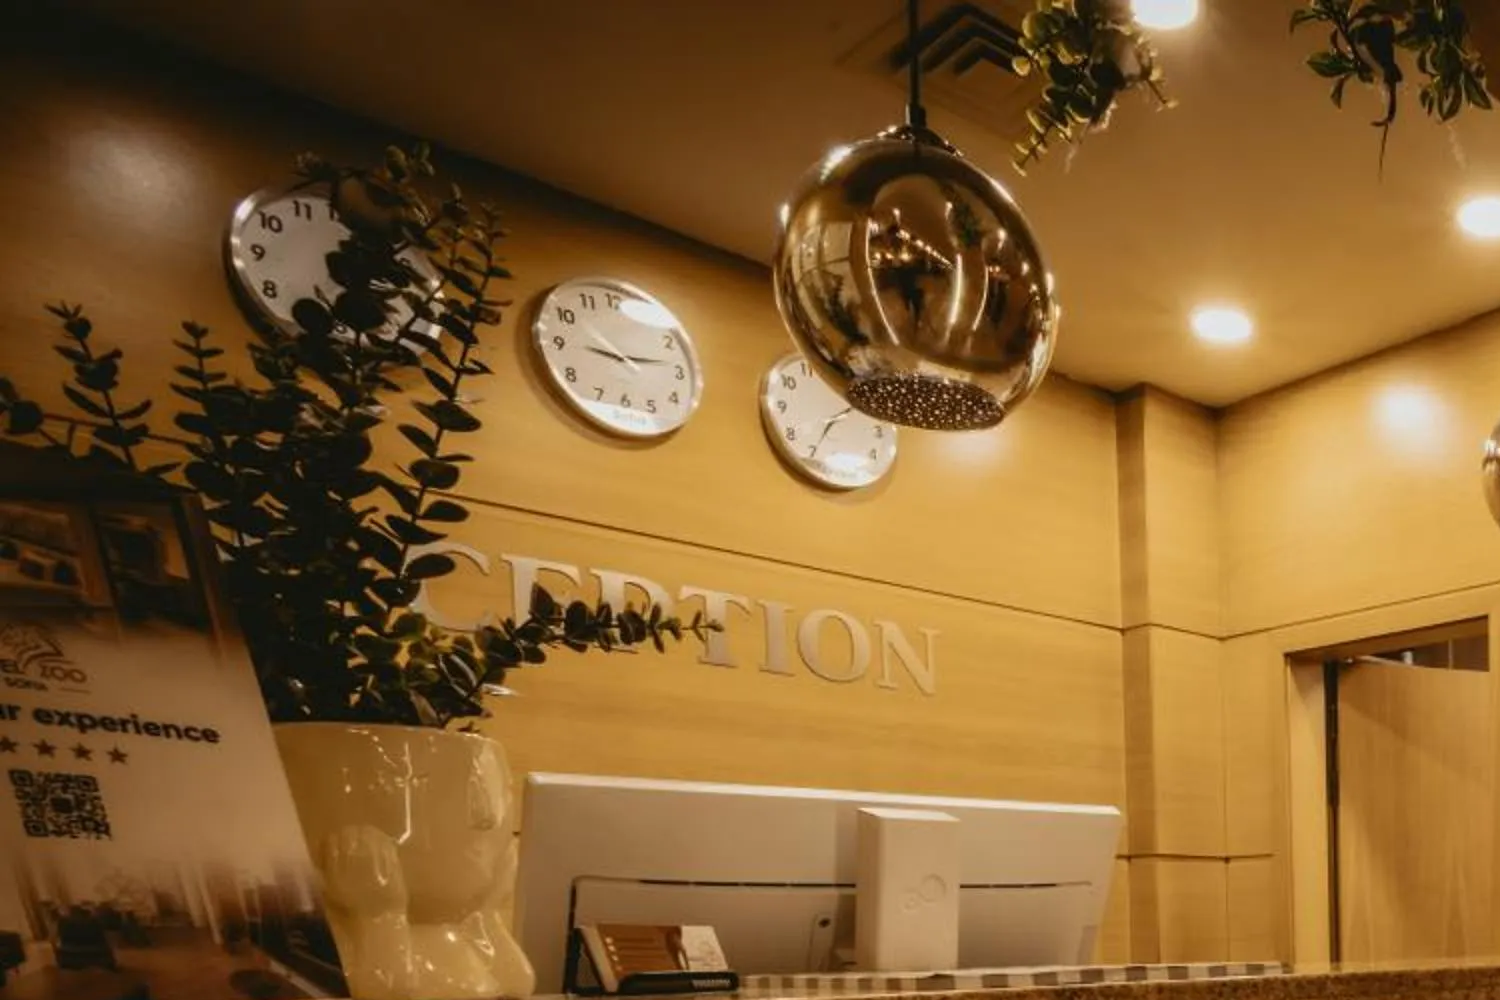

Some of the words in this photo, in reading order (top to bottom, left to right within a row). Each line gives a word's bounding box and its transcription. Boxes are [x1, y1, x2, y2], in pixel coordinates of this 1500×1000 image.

[293, 200, 312, 221] 11
[258, 211, 283, 233] 10
[250, 244, 266, 261] 9
[262, 280, 277, 299] 8
[579, 293, 596, 311] 11
[556, 307, 575, 325] 10
[553, 335, 566, 350] 9
[663, 335, 674, 349] 2
[564, 367, 577, 383] 8
[674, 365, 686, 381] 3
[780, 374, 797, 391] 10
[593, 387, 605, 401] 7
[619, 393, 632, 408] 6
[668, 391, 679, 404] 4
[645, 399, 657, 414] 5
[777, 400, 788, 414] 9
[785, 427, 796, 441] 8
[808, 445, 817, 458] 7
[404, 540, 942, 696] CEPTION
[32, 708, 221, 744] experience
